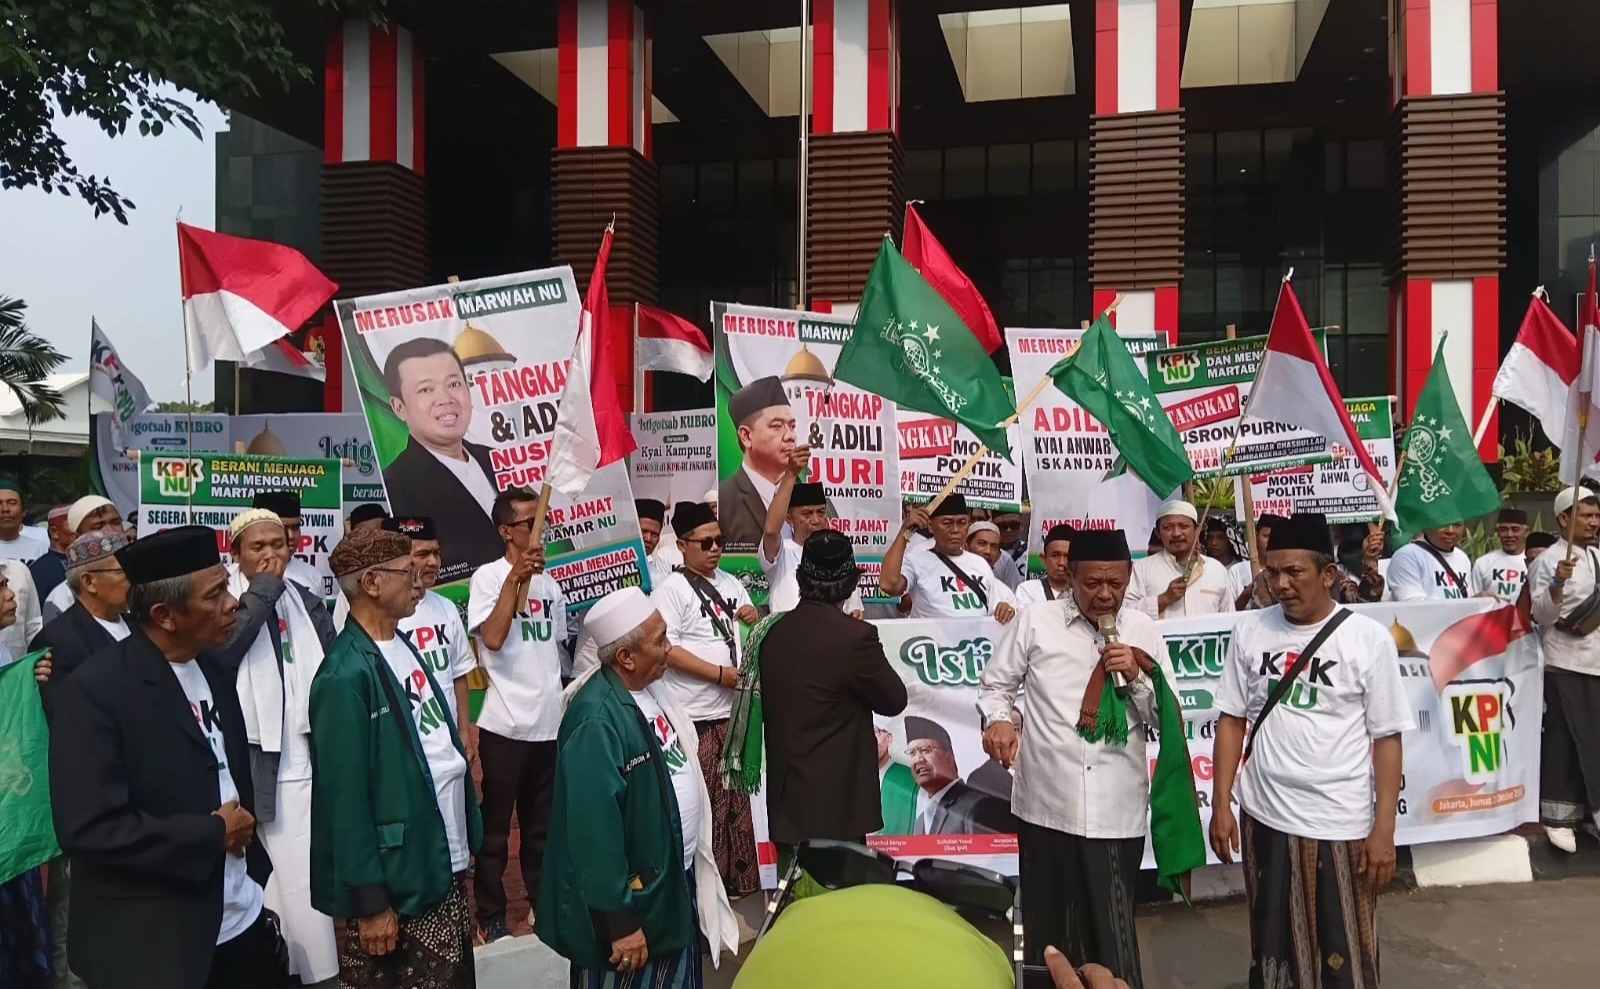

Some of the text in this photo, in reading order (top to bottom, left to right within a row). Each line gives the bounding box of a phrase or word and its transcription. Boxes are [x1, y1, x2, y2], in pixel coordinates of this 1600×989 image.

[355, 283, 562, 332] MERUSAK MARWAH NU
[724, 315, 796, 338] MERUSAK
[1018, 338, 1078, 354] MERUSA
[1160, 352, 1196, 368] KPK
[1206, 355, 1231, 367] DAN
[1167, 366, 1191, 380] NU
[1207, 363, 1258, 379] MARTAB
[805, 390, 882, 420] TANGKAP
[1346, 402, 1376, 413] JAGA
[174, 421, 223, 434] KUBRO
[490, 399, 561, 443] & AD
[638, 414, 716, 434] Istigotsah KUBRO
[1034, 407, 1108, 432] ADIL
[809, 423, 882, 452] & ADILI
[898, 424, 953, 450] NGKAP
[641, 444, 712, 461] Kyai Kampung
[1034, 437, 1111, 455] KYAI ANWAR
[319, 436, 374, 475] Istig
[1036, 457, 1114, 470] ISKANDAR
[1354, 456, 1389, 469] UNG
[157, 462, 200, 478] KPK
[211, 460, 325, 476] BERANI MENJAGA
[808, 458, 884, 485] JURI
[1195, 459, 1219, 470] AKA
[164, 477, 190, 493] NU
[211, 474, 318, 488] DAN MENGAWAL
[1269, 474, 1314, 487] MONEY
[1321, 472, 1351, 484] AHWA
[824, 487, 883, 498] DIANTORO
[920, 483, 928, 491] DI
[1267, 485, 1316, 498] POLITIK
[569, 497, 612, 521] JAHAT
[1255, 499, 1292, 509] RUMAH
[148, 510, 334, 527] SEGERA KEMBALI SYWAH
[597, 515, 617, 529] NU
[829, 519, 889, 533] SIR JAHAT
[298, 535, 328, 553] PK
[872, 535, 887, 545] NU
[547, 548, 637, 580] ERANI MENJAGA
[573, 562, 638, 589] MENGAWAL
[562, 580, 621, 606] ARTABAT
[952, 592, 984, 610] NU
[521, 621, 553, 642] NU
[900, 636, 992, 687] Isti
